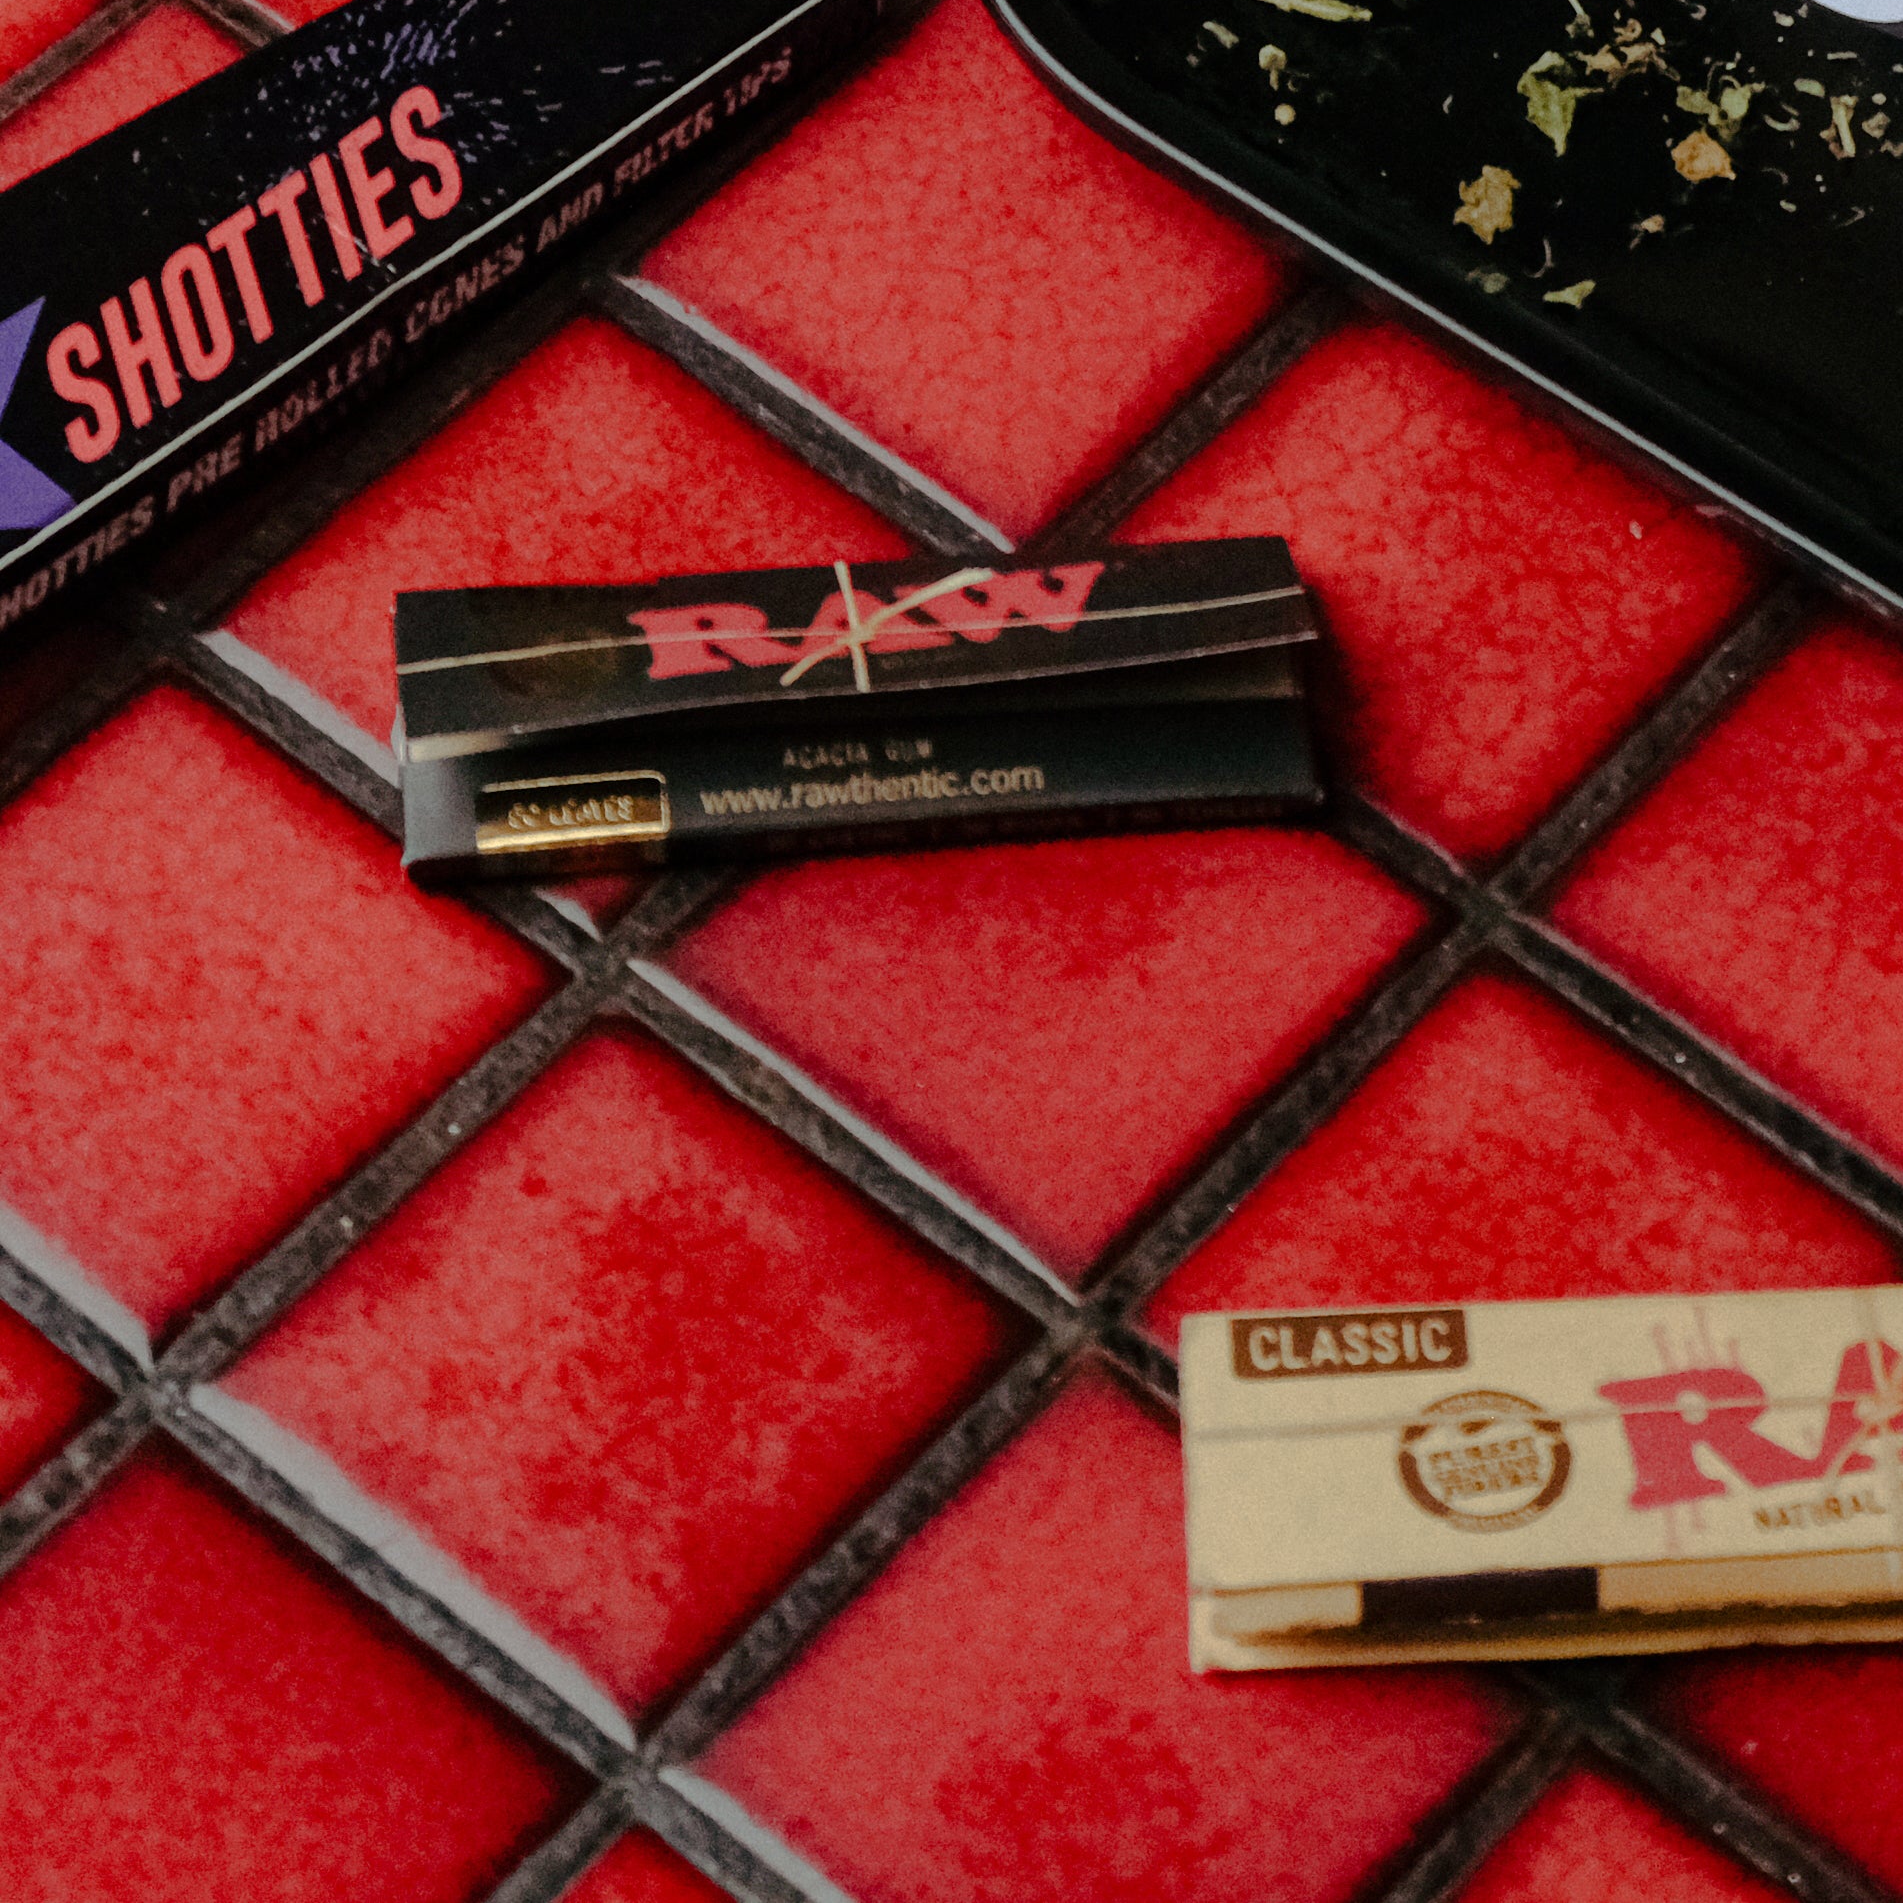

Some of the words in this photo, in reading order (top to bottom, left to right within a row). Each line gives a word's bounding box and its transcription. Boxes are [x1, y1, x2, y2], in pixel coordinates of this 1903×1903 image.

[46, 85, 463, 465] SHOTTIES
[0, 497, 156, 621] HOTTIES
[166, 447, 243, 517] PRE
[404, 238, 527, 341] CONES
[535, 181, 605, 254] AND
[613, 113, 717, 198] FILTER
[628, 561, 1107, 681] RAW
[699, 762, 1045, 816] www.rawthentic.com
[1248, 1318, 1453, 1372] CLASSIC
[1752, 1485, 1886, 1531] NATURAL
